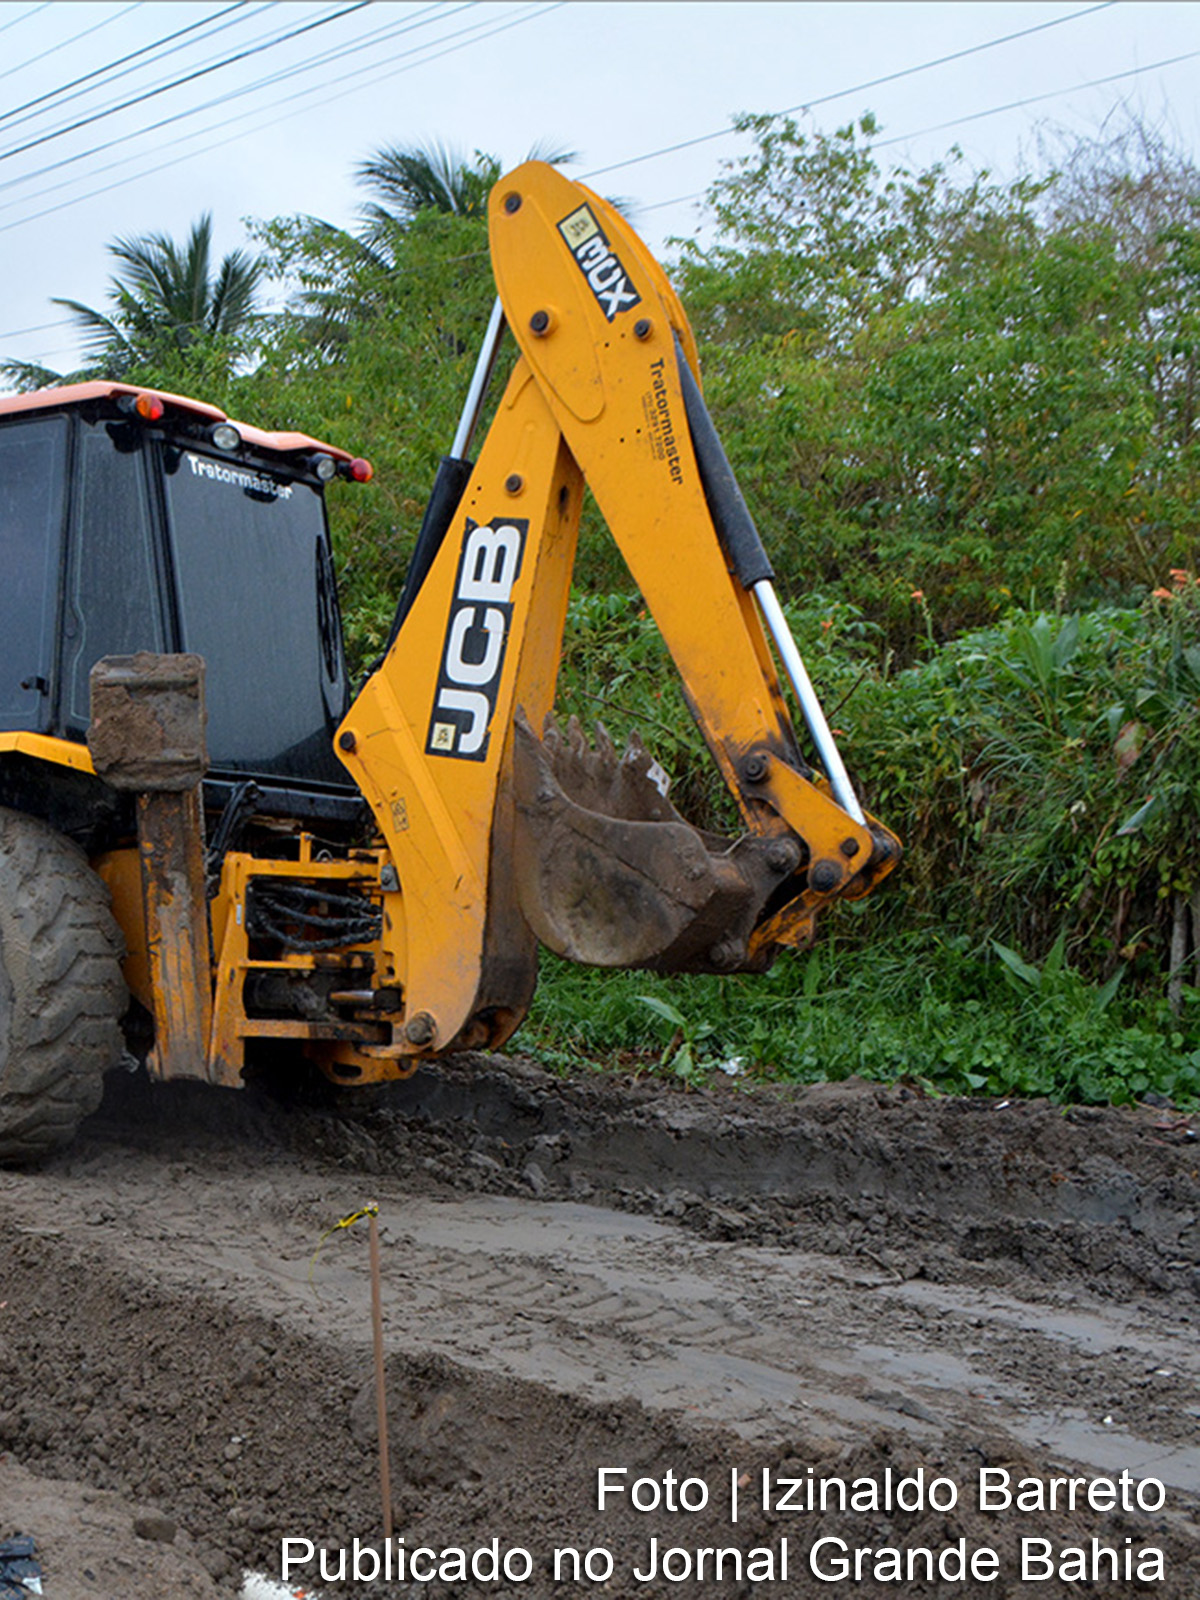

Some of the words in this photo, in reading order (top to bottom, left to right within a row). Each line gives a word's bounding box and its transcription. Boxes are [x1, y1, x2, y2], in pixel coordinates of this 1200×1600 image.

[187, 455, 294, 499] Tratormaster
[649, 358, 683, 486] Tratormaster
[437, 524, 522, 754] JCB
